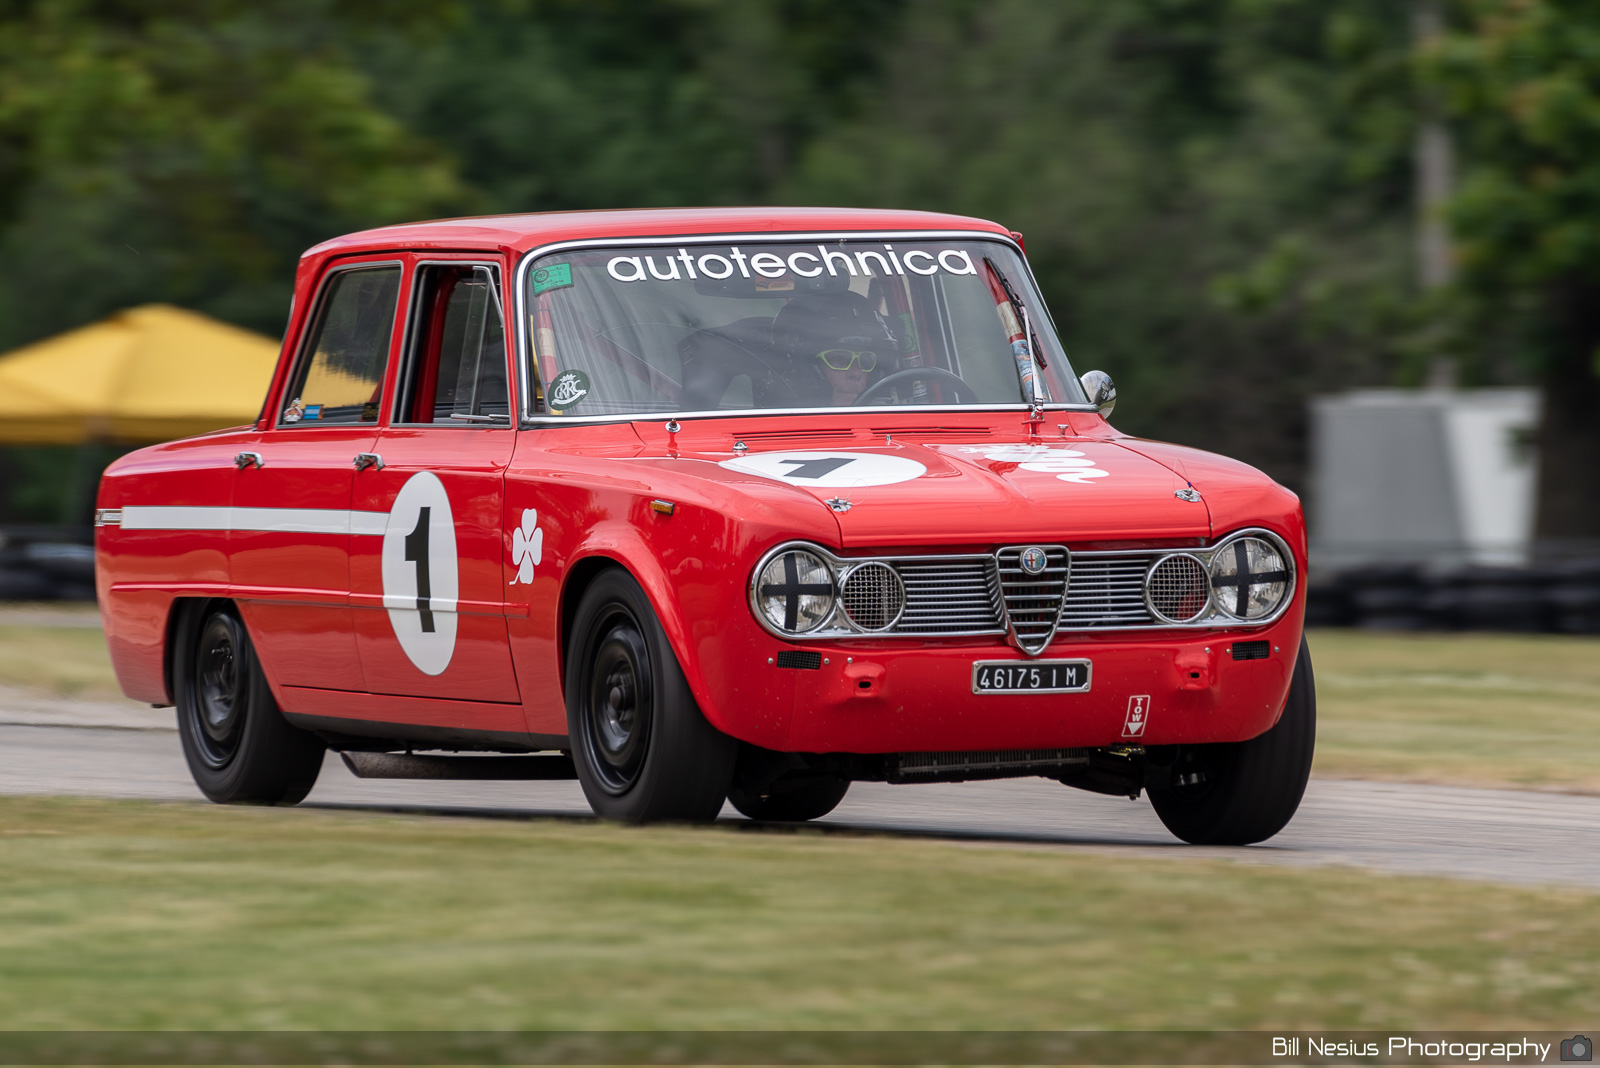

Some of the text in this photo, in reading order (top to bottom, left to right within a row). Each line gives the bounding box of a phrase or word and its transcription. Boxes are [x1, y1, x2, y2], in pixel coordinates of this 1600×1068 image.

[606, 244, 978, 282] autotechnica
[778, 457, 857, 479] 1
[404, 506, 436, 633] 1
[980, 668, 1041, 689] 46175
[1132, 697, 1143, 722] TOW
